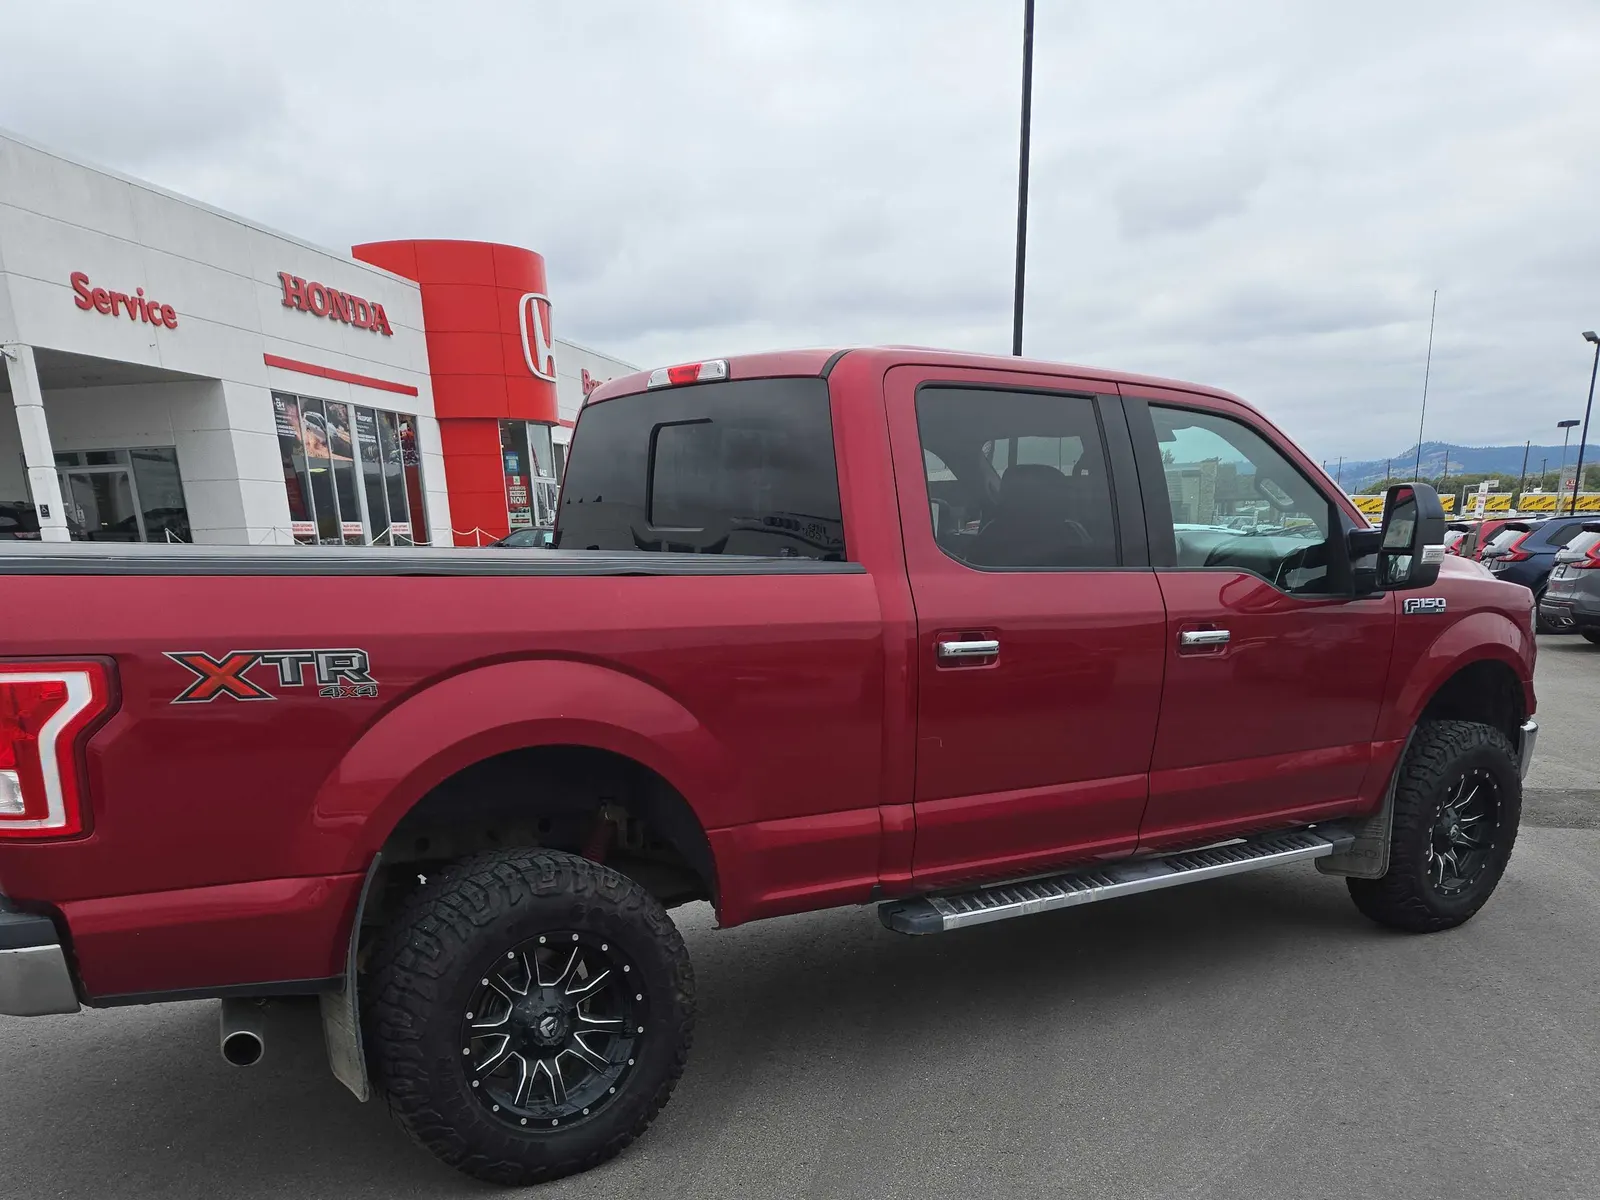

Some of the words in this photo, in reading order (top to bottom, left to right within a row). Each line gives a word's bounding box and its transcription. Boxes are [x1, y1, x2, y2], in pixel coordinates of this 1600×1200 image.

[70, 271, 178, 329] Service
[277, 271, 393, 336] HONDA
[510, 496, 527, 505] NOW
[1404, 597, 1447, 615] F150
[161, 647, 380, 705] XTR
